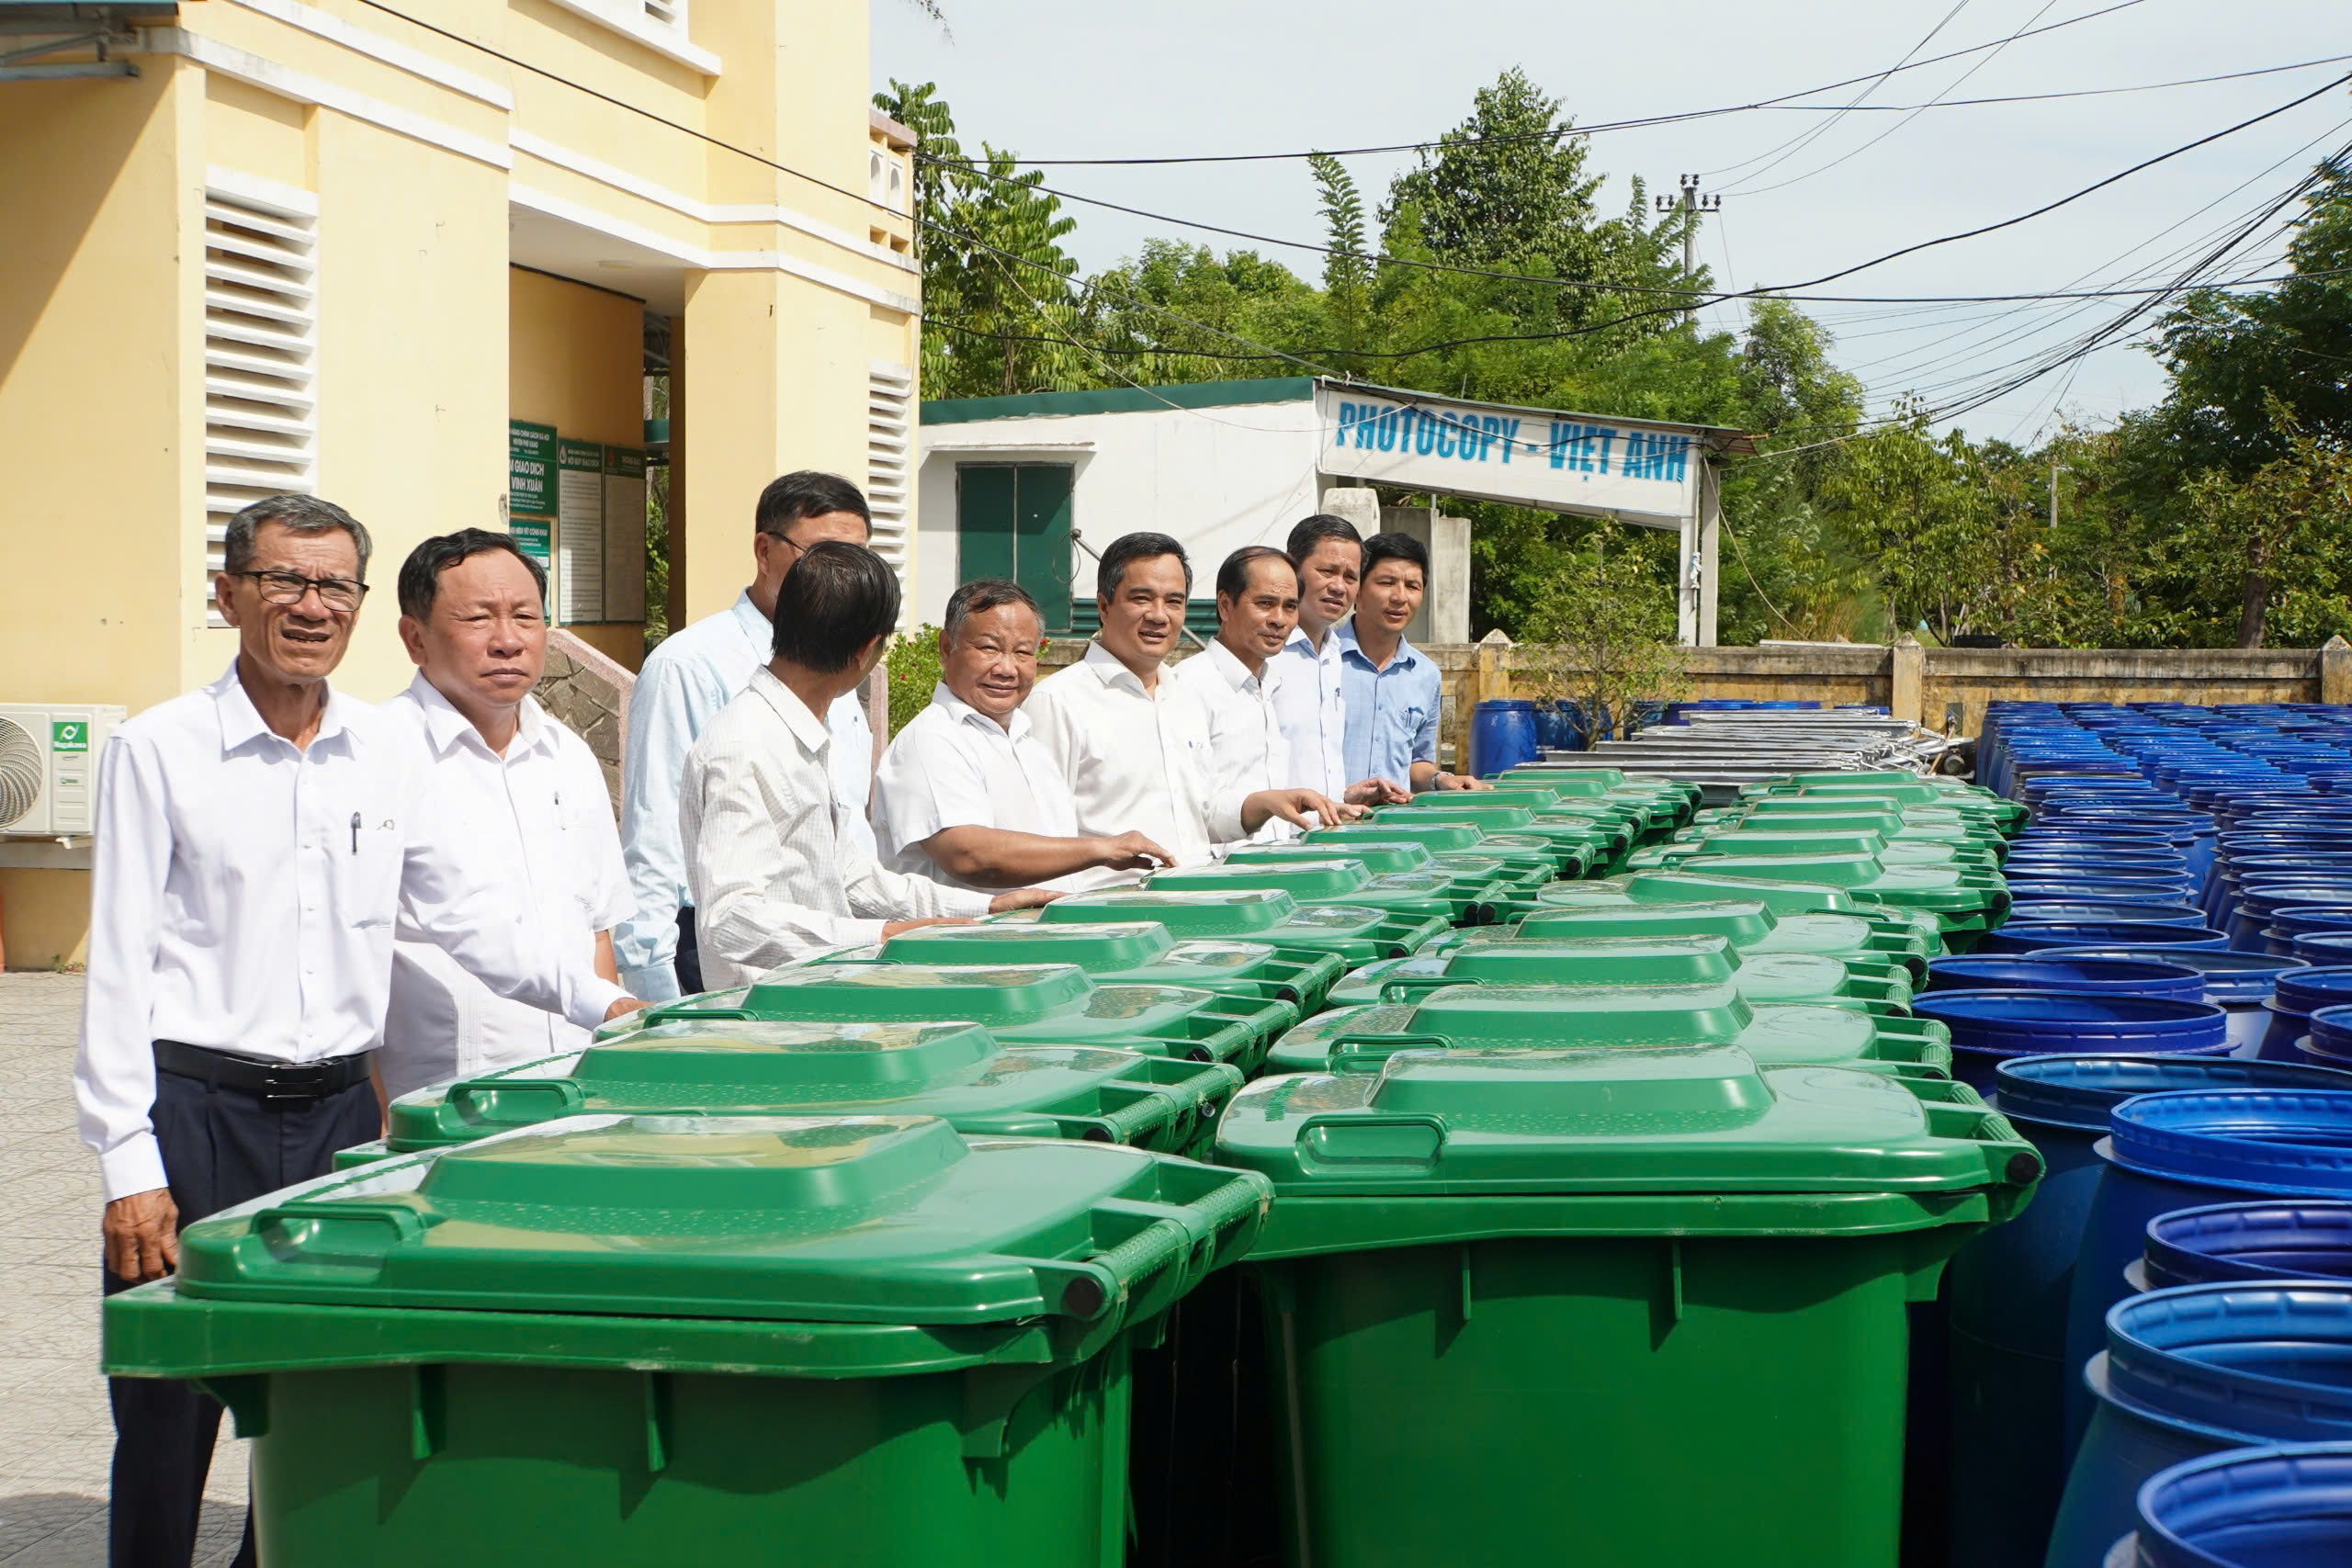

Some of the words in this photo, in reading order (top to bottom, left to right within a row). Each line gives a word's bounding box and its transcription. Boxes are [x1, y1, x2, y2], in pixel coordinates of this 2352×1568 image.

[1336, 400, 1522, 464] PHOTOCOPY
[1623, 431, 1690, 482] ANH
[514, 459, 530, 474] GIAO
[530, 461, 545, 477] DỊCH
[511, 476, 526, 491] VINH
